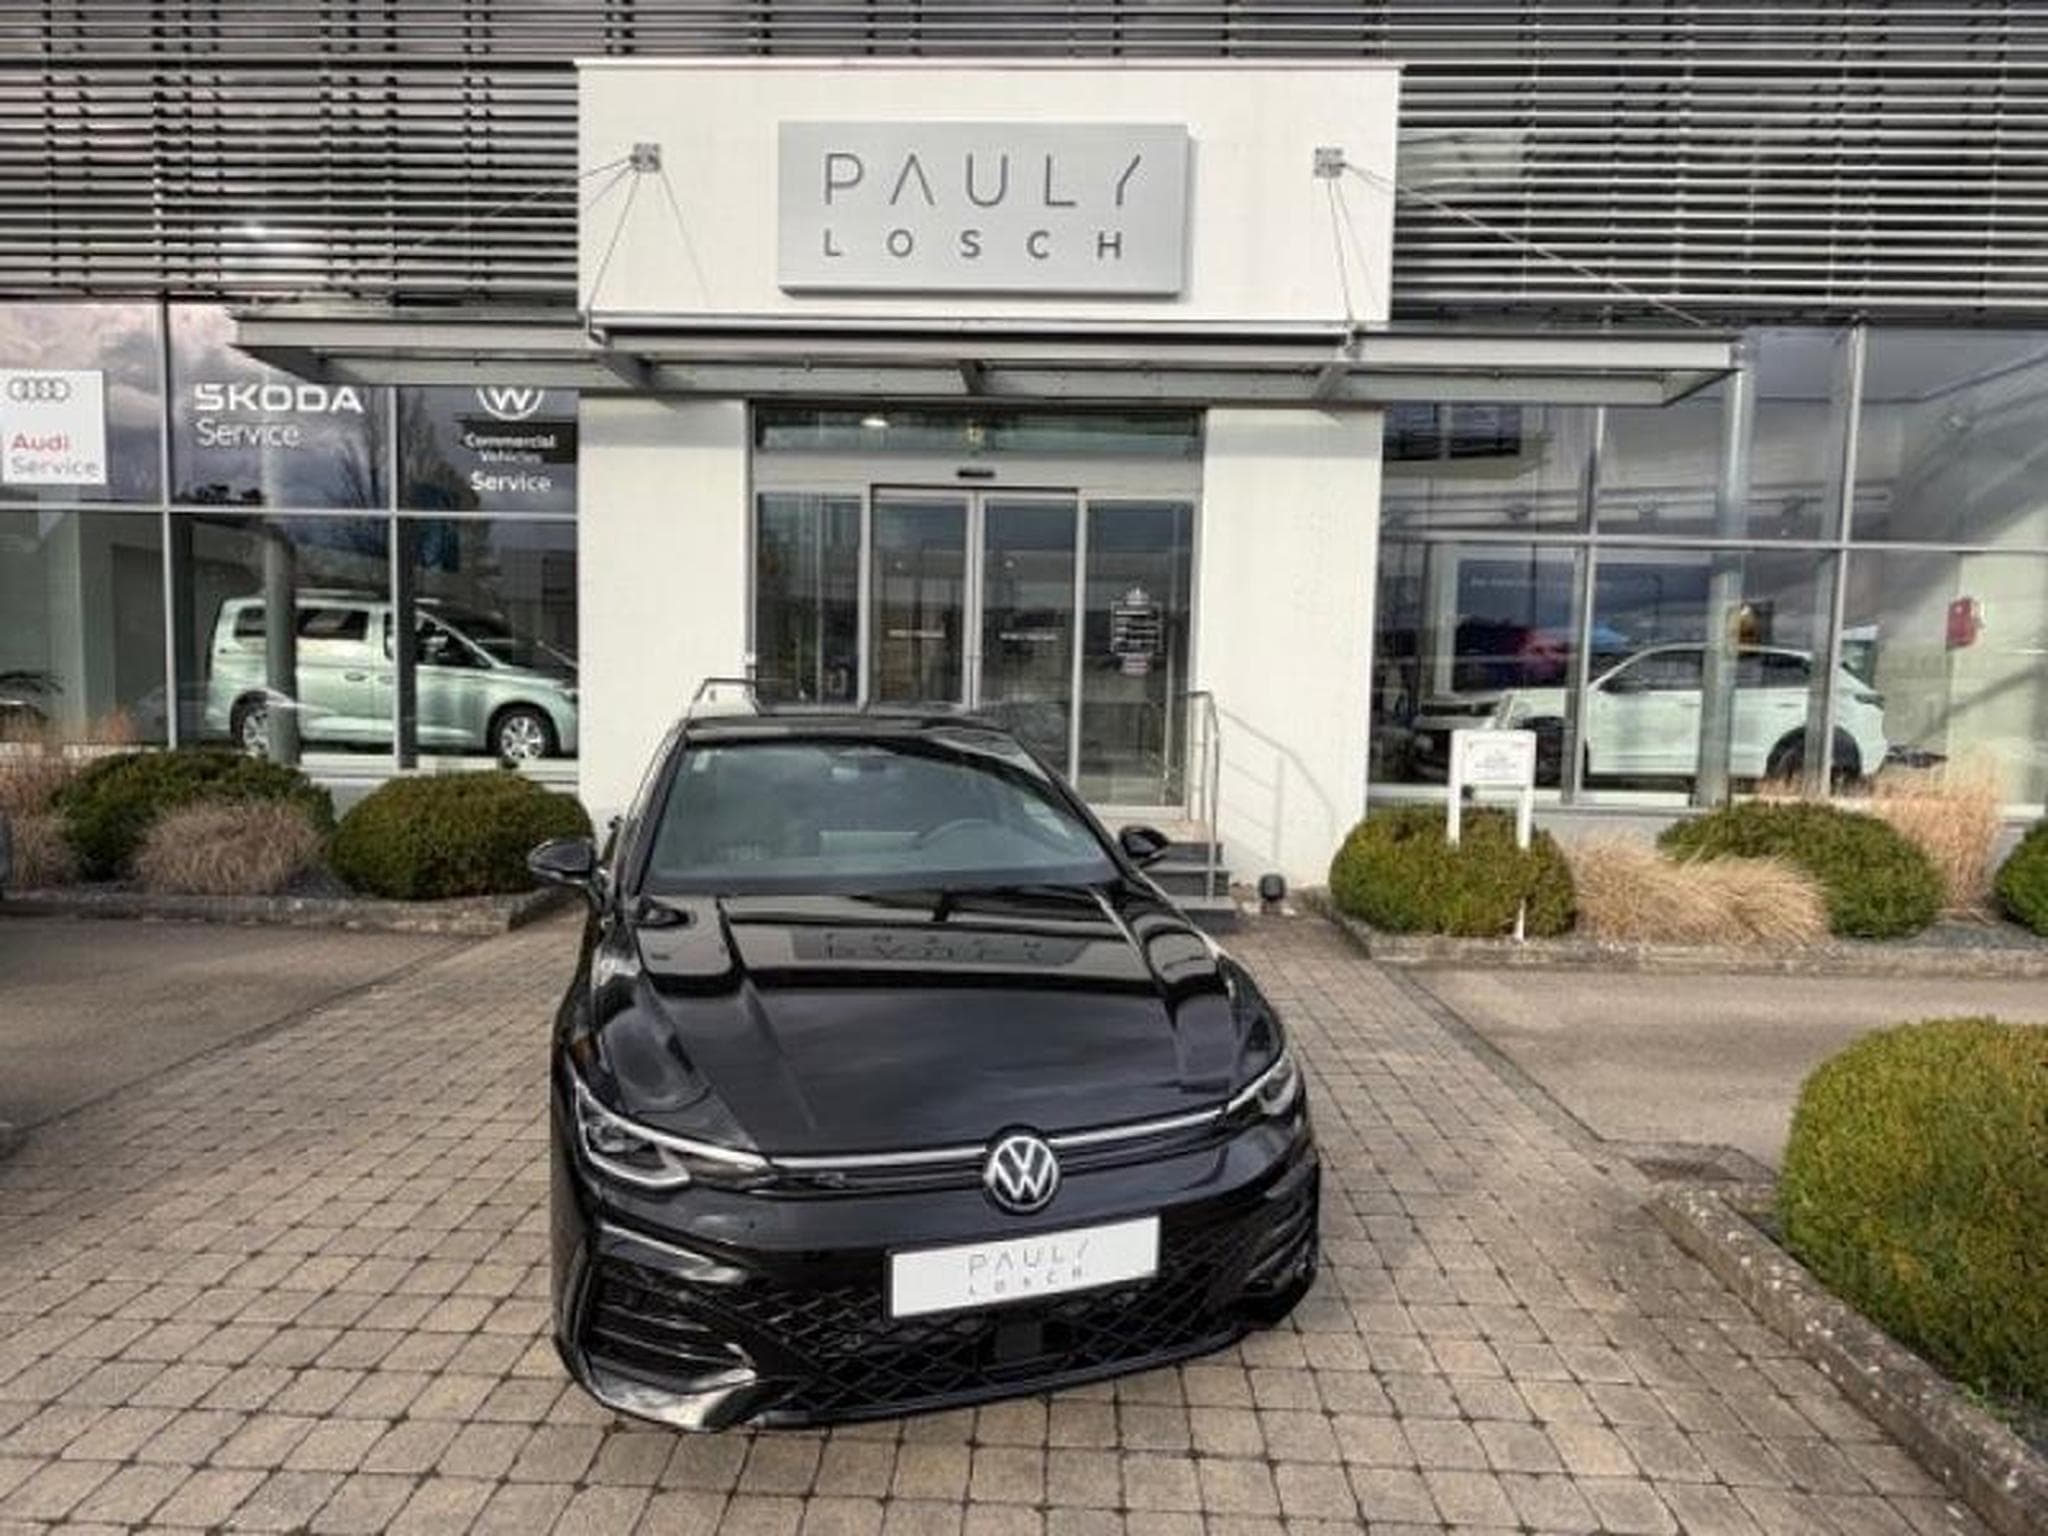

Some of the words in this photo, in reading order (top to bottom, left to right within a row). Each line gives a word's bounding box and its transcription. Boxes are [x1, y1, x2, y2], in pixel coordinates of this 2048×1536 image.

[823, 152, 1142, 207] PAULY
[822, 229, 1122, 260] LOSCH
[11, 432, 70, 452] Audi
[195, 418, 301, 447] Service
[11, 456, 100, 477] Service
[469, 471, 553, 493] Service
[967, 1237, 1090, 1278] PAULY
